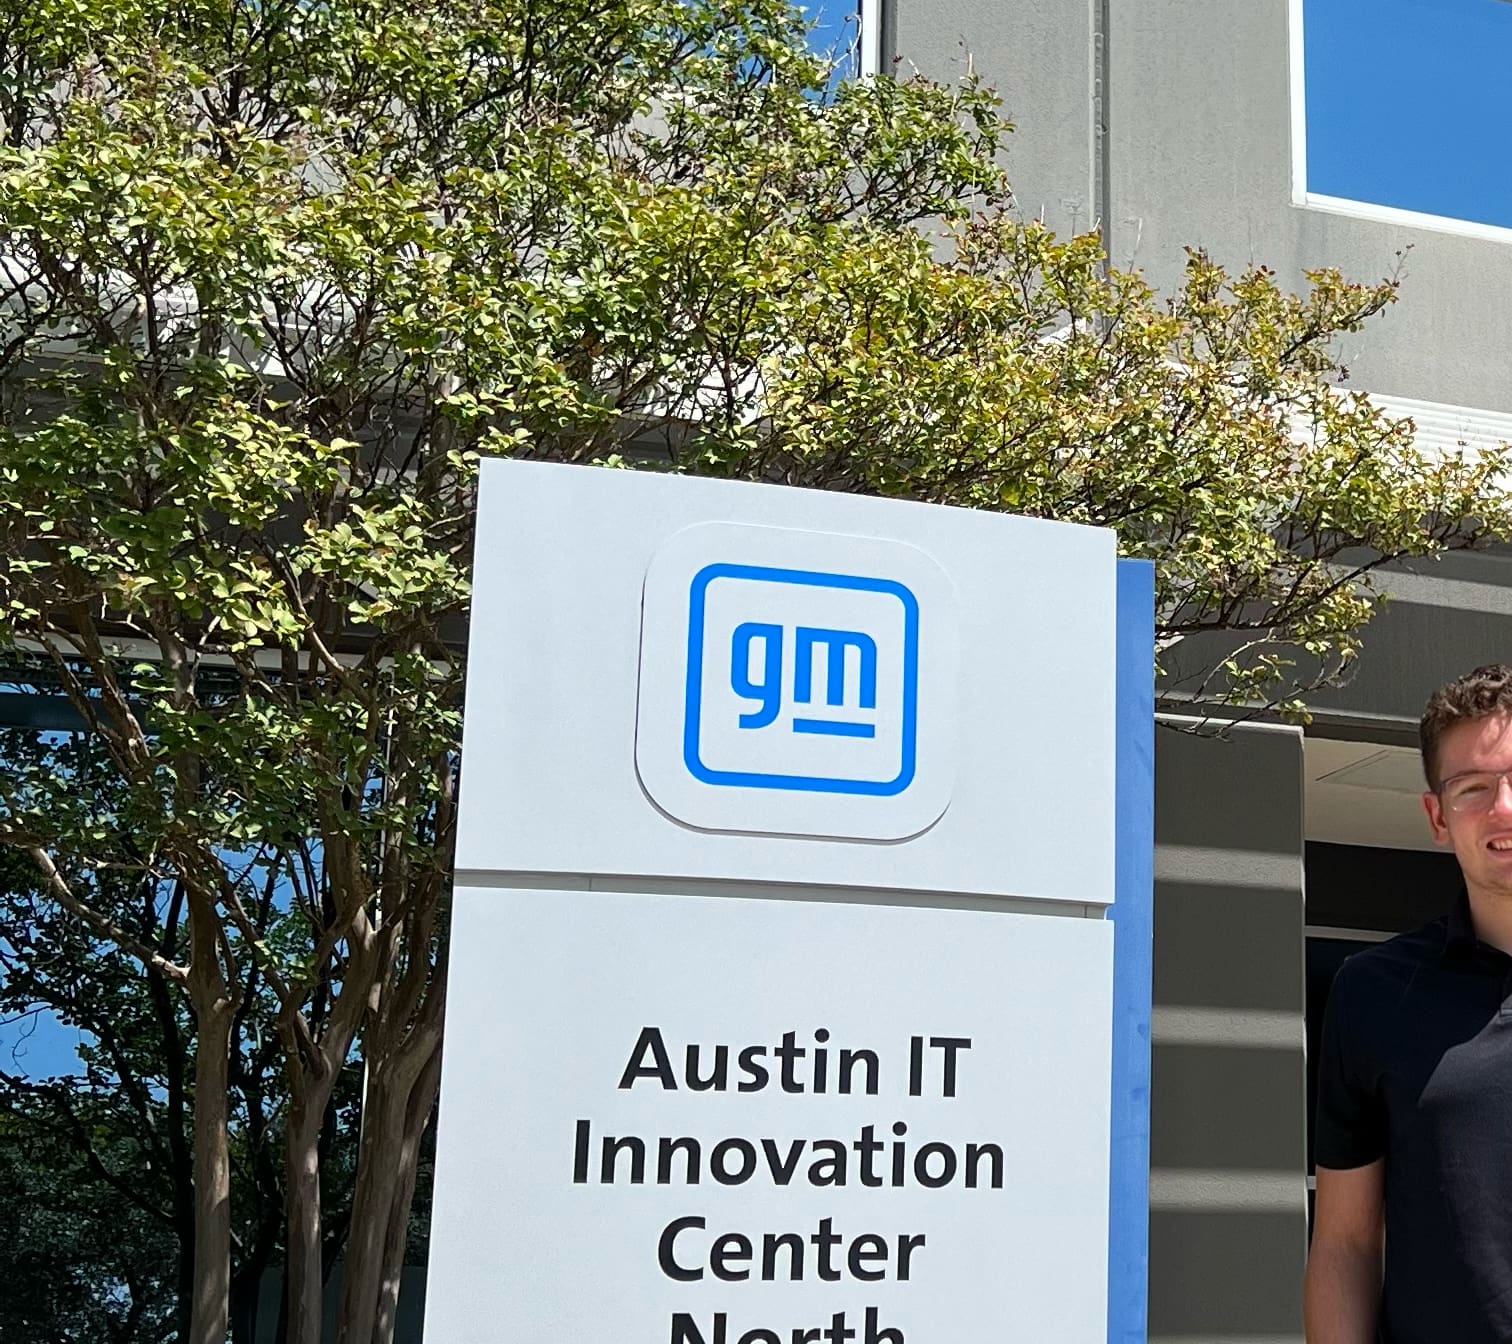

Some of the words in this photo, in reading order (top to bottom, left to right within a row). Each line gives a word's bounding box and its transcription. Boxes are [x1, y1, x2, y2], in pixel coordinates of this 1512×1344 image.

[730, 621, 878, 730] gm
[618, 1027, 880, 1096] Austin
[909, 1035, 972, 1098] IT
[573, 1119, 1004, 1189] Innovation
[657, 1215, 926, 1282] Center
